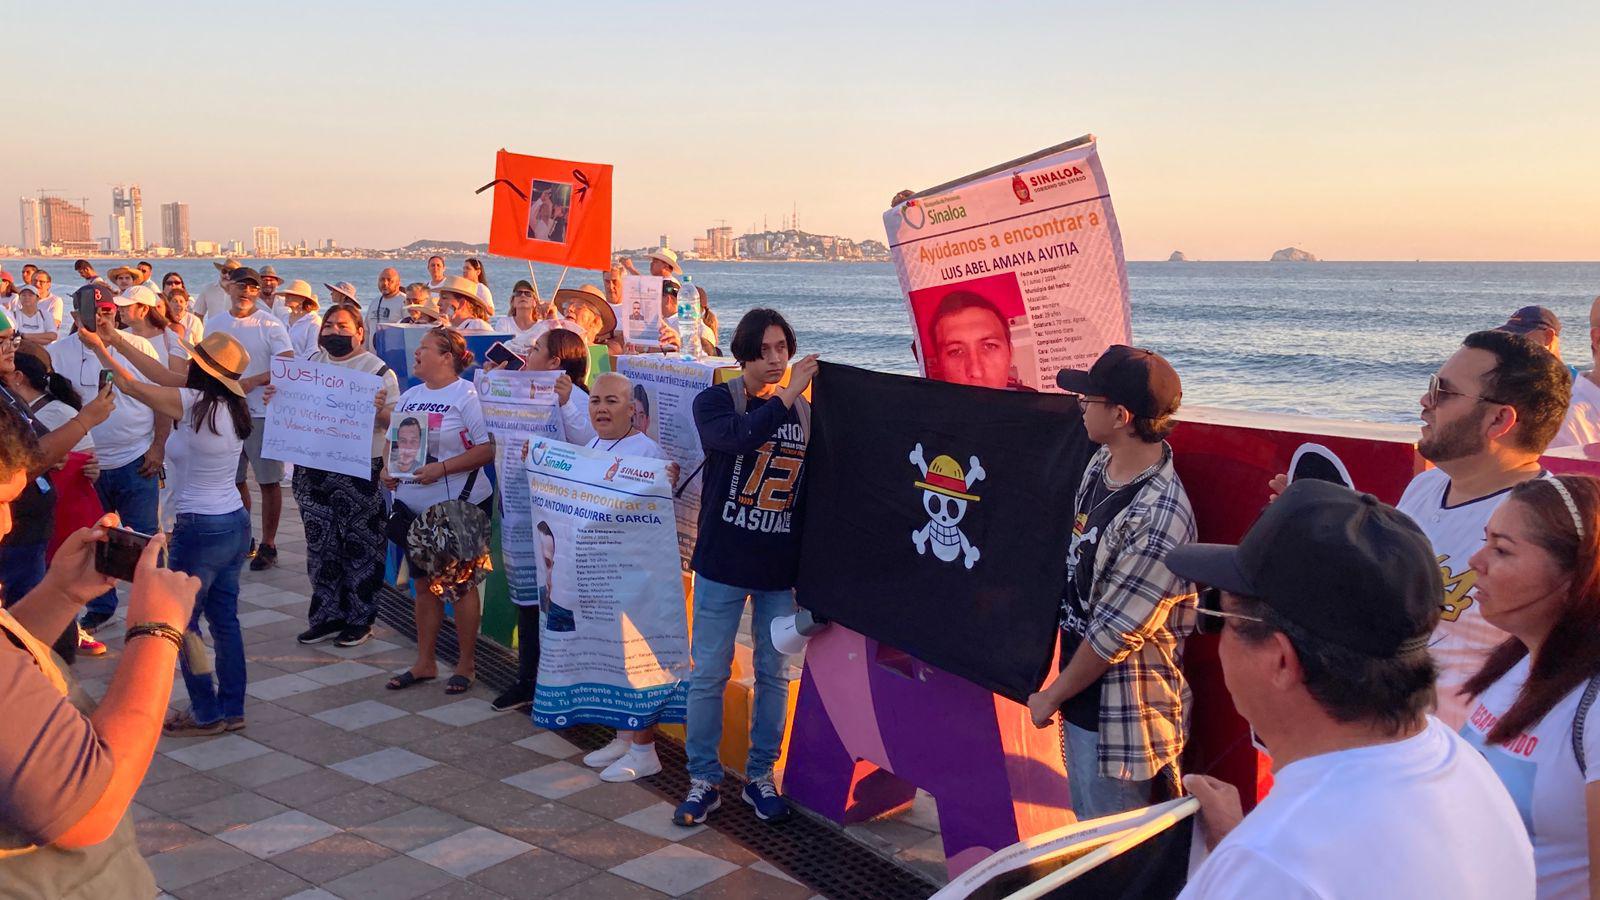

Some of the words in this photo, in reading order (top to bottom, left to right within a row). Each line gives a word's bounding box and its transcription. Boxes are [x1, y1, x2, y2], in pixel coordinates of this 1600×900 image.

[1030, 166, 1083, 187] SINALOA
[1034, 182, 1057, 193] GOBIERNO
[1067, 175, 1087, 186] ESTADO
[928, 204, 967, 225] Sinaloa
[919, 238, 986, 265] Ayúdanos
[991, 236, 1000, 247] a
[1003, 214, 1083, 244] encontrar
[1088, 212, 1100, 226] a
[941, 265, 962, 281] LUIS
[965, 261, 991, 276] ABEL
[992, 251, 1036, 271] AMAYA
[1038, 241, 1079, 261] AVITIA
[272, 358, 344, 388] Justicia
[417, 403, 451, 413] BUSCA
[544, 455, 572, 471] Sinaloa
[620, 466, 655, 481] SINALOA
[742, 441, 804, 512] 12
[531, 477, 569, 497] Ayúdanos
[571, 488, 578, 499] a
[580, 491, 641, 512] encontrar
[648, 501, 657, 511] a
[544, 499, 573, 516] ANTONIO
[574, 506, 612, 522] AGUIRRE
[615, 513, 662, 525] GARCÍA
[722, 500, 791, 533] CASUAL
[571, 686, 612, 695] referente
[624, 690, 643, 699] esta
[572, 696, 601, 704] ayuda
[615, 699, 634, 708] muy
